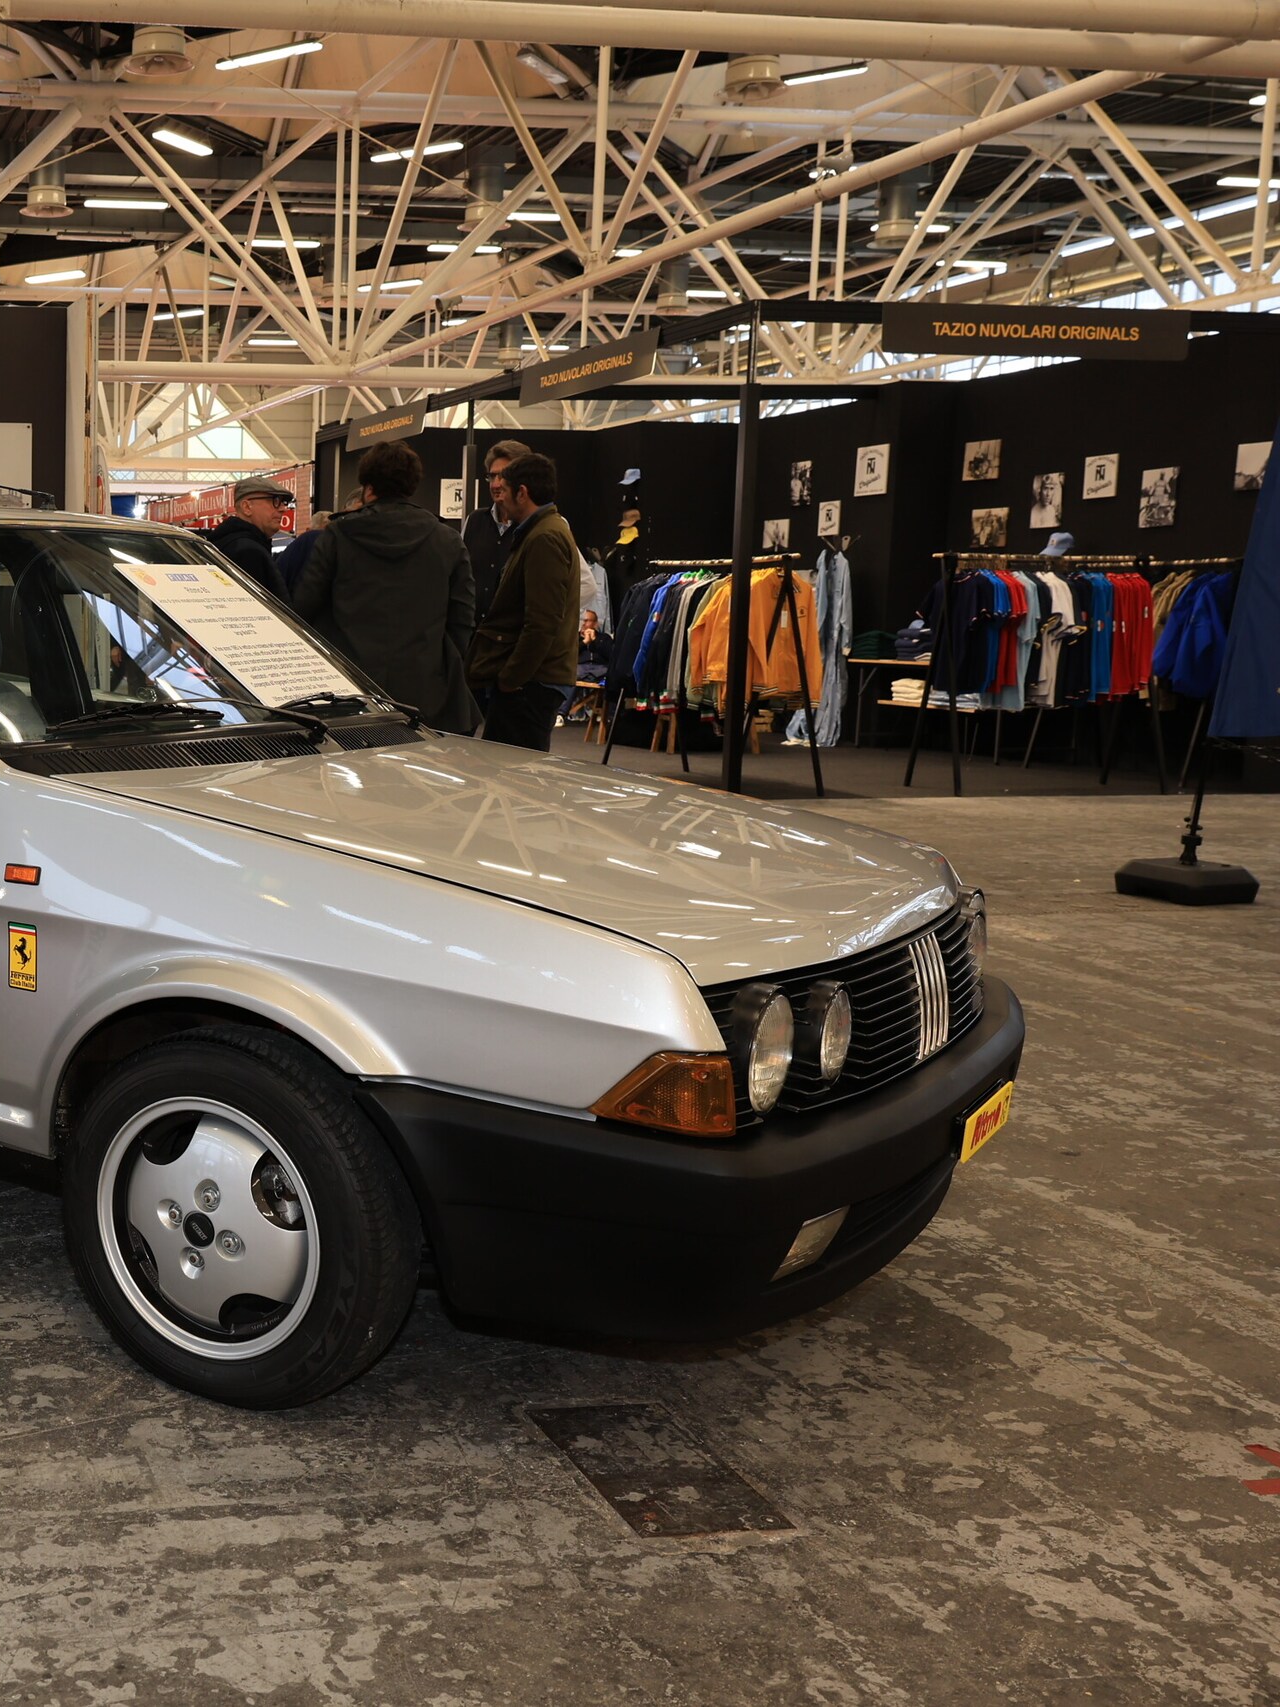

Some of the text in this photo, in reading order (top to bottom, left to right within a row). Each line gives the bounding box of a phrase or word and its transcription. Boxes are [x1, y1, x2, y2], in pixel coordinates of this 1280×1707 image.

[933, 321, 1140, 341] TAZIO NUVOLARI ORIGINALS
[540, 352, 633, 388] TAZIO NUVOLARI ORIGINALS
[11, 971, 35, 982] Ferrari
